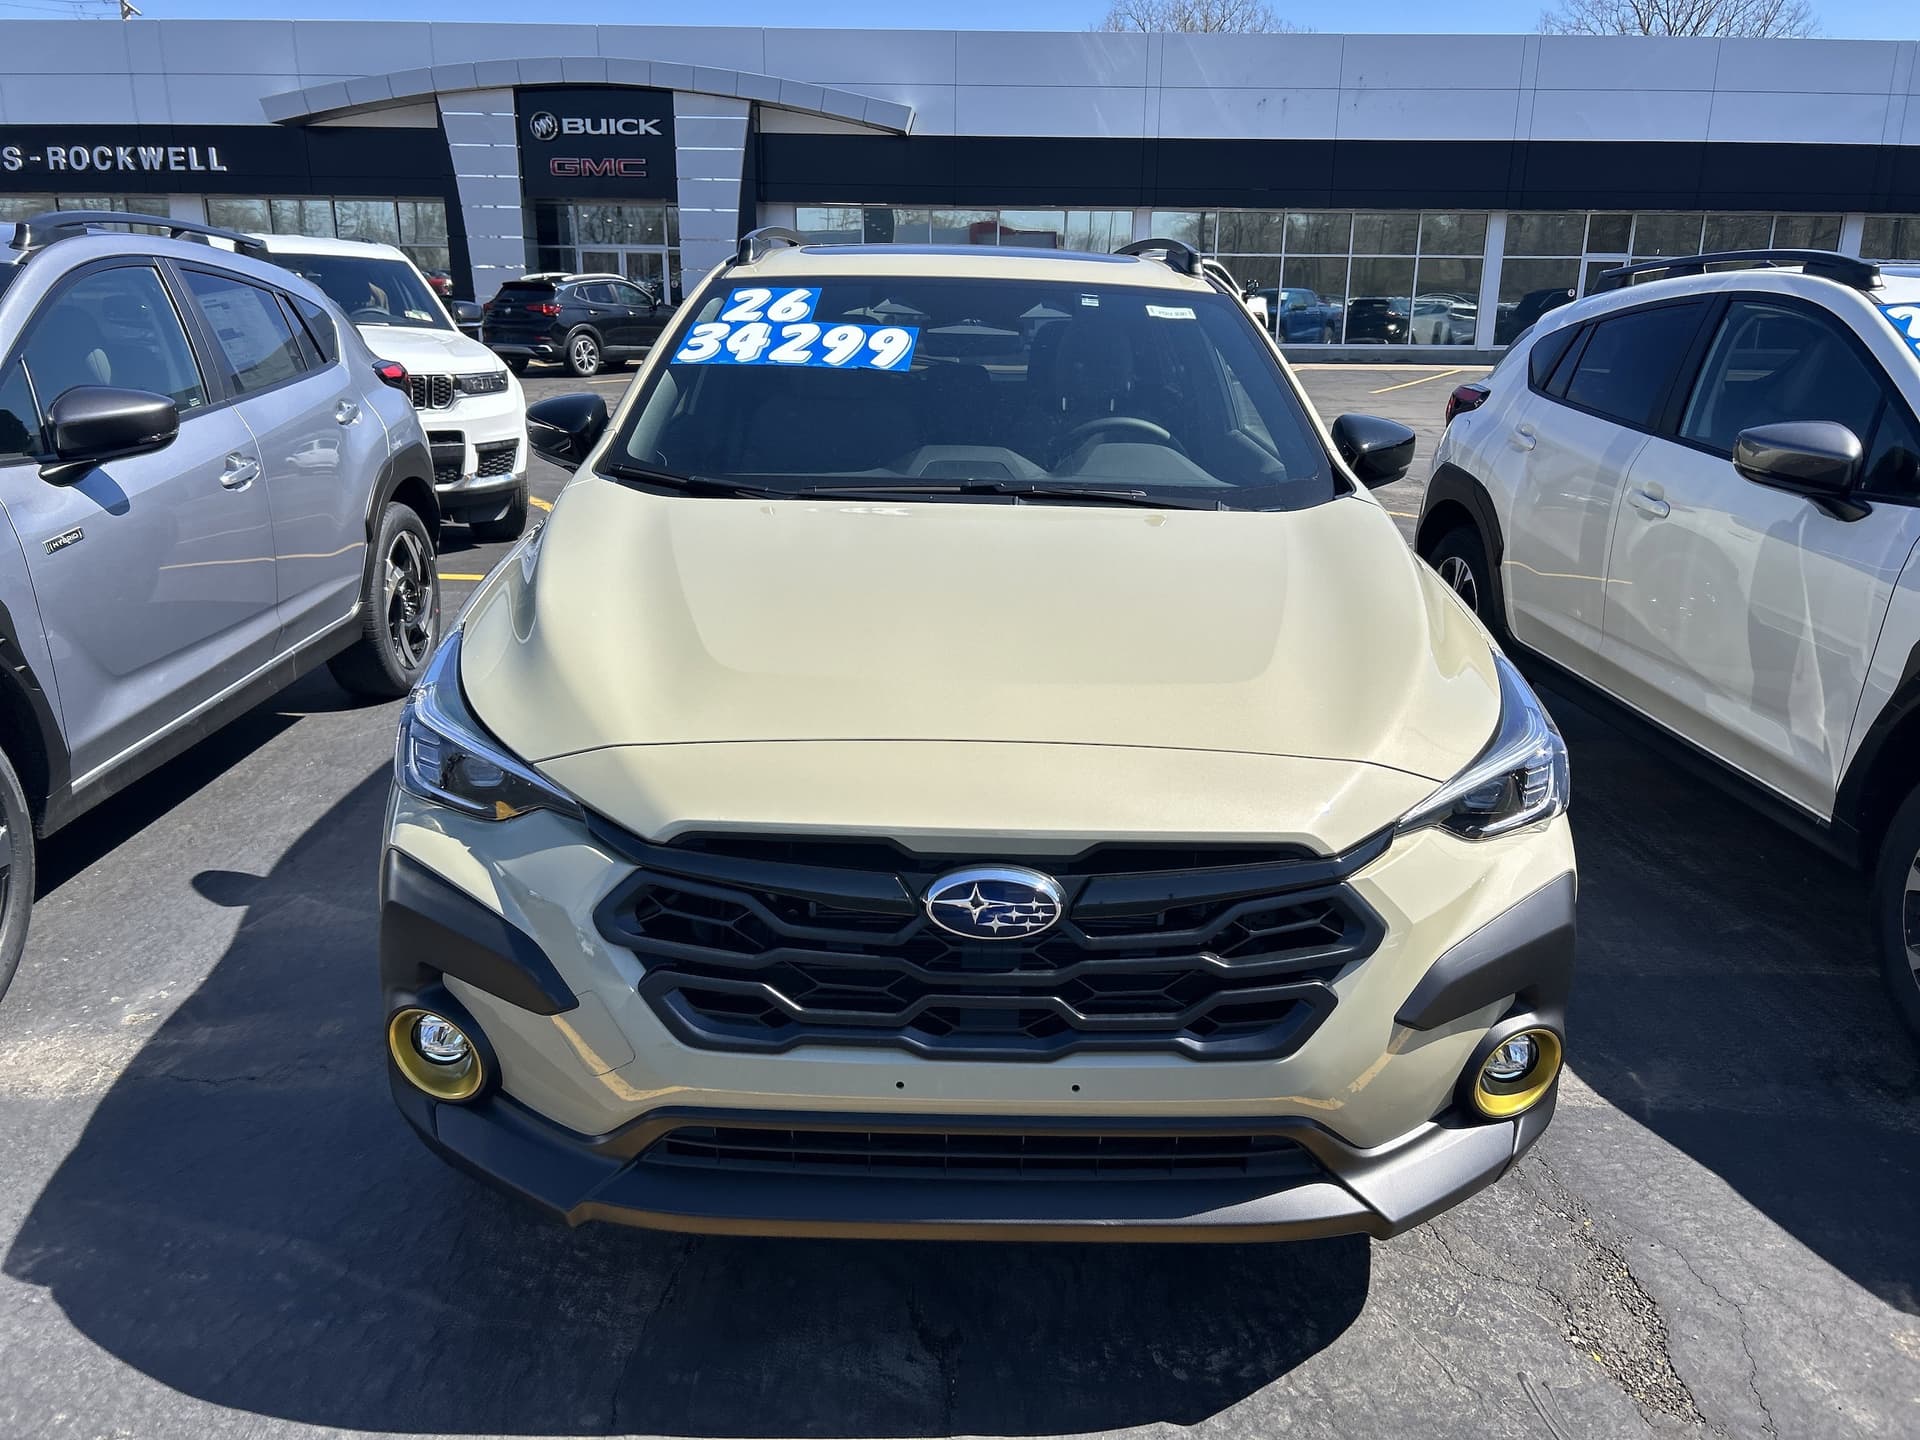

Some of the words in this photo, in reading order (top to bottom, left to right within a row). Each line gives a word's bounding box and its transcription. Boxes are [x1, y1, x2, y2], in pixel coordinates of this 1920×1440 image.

[561, 118, 662, 136] BUICK
[550, 157, 647, 177] GMC
[721, 288, 813, 322] 26
[676, 322, 912, 369] 34299
